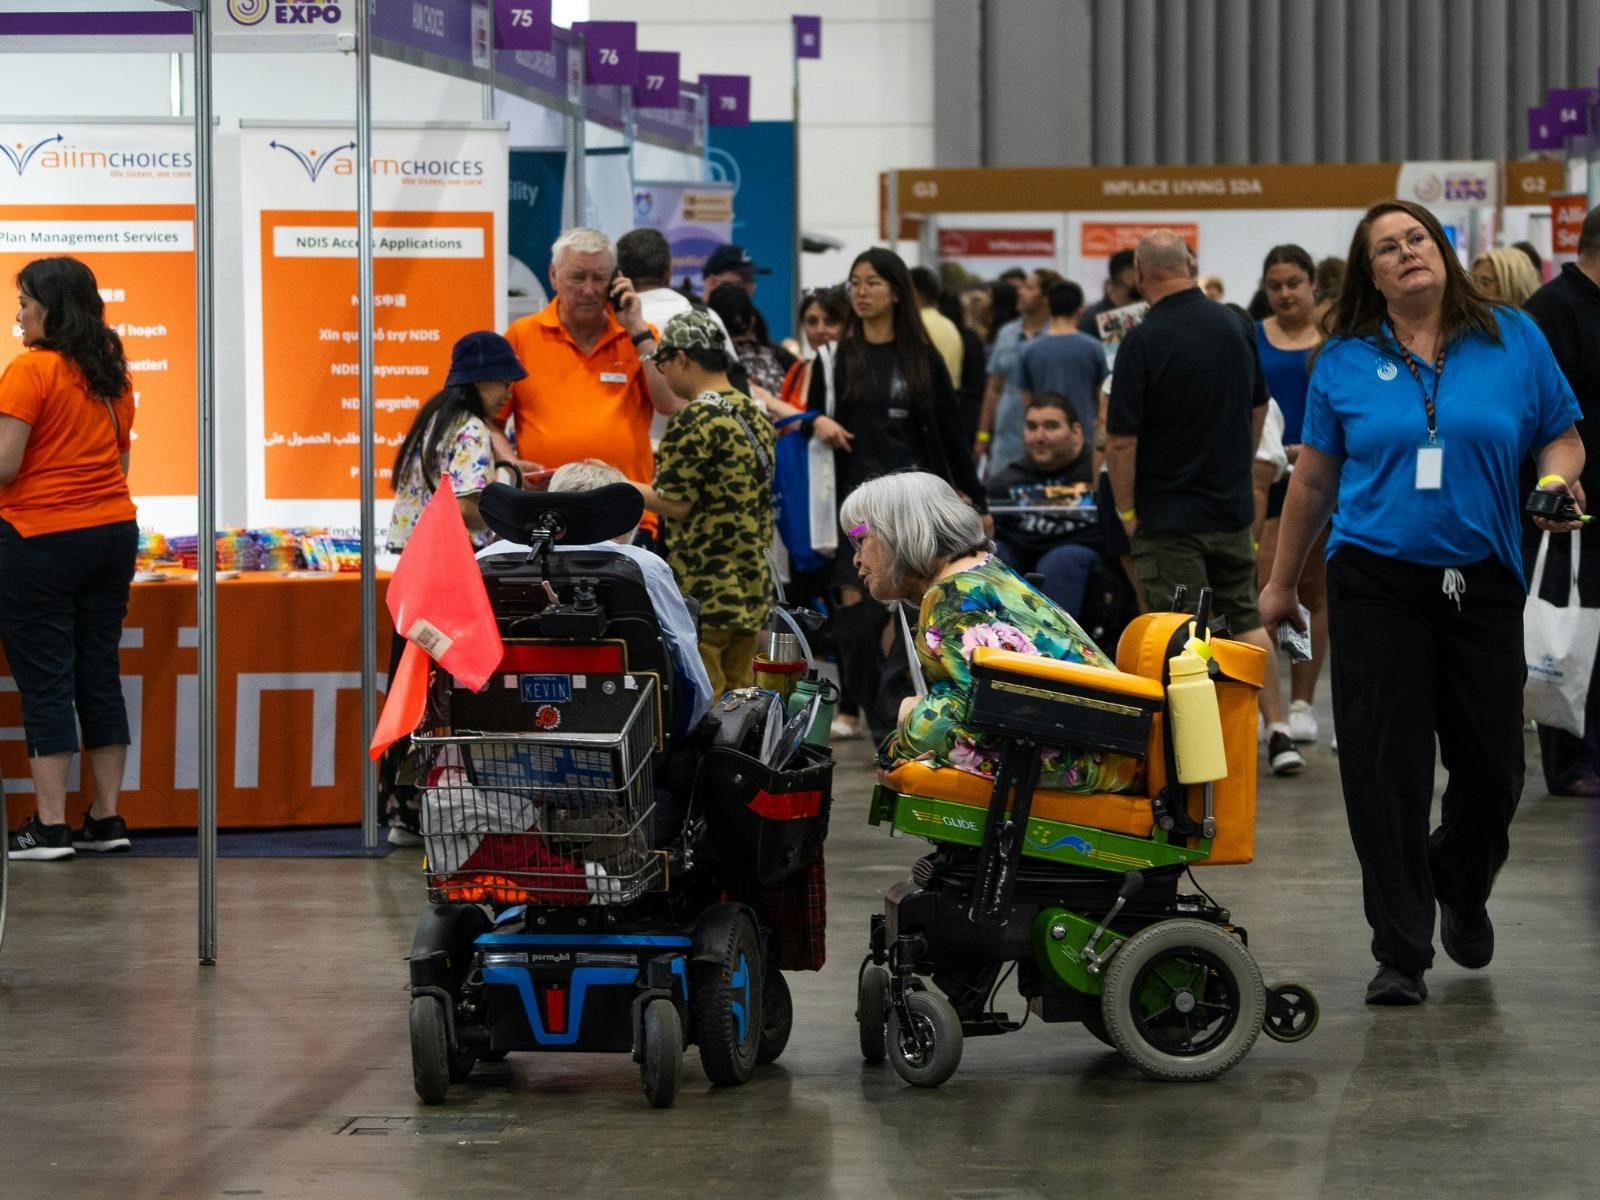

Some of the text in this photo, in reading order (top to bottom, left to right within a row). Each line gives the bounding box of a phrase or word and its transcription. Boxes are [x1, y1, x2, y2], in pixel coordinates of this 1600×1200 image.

[276, 5, 342, 24] EXPO
[511, 9, 533, 27] 75
[600, 49, 619, 65] 76
[646, 75, 665, 91] 77
[31, 232, 119, 245] Management
[124, 231, 179, 243] Services
[296, 237, 329, 248] NDIS
[380, 237, 463, 251] Applications
[409, 329, 440, 341] NDIS
[524, 683, 567, 698] KEVIN
[942, 816, 979, 832] GLIDE
[532, 952, 570, 962] permobil
